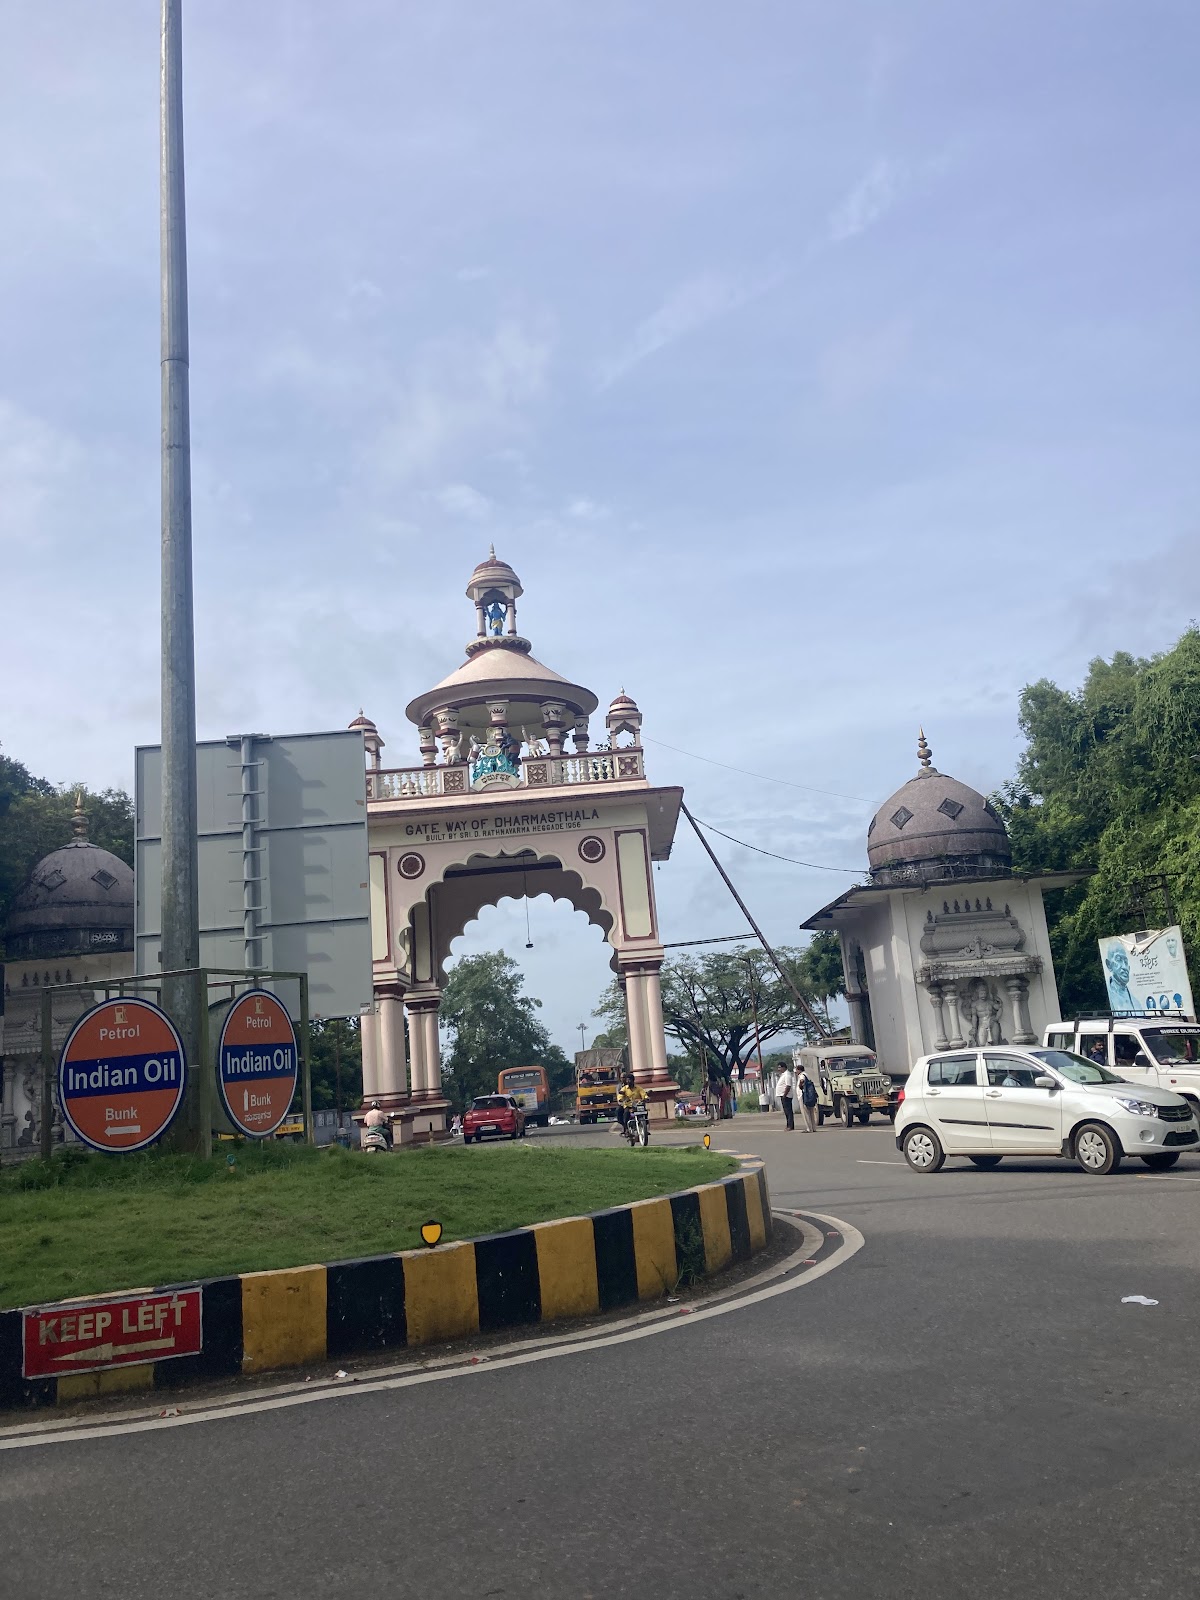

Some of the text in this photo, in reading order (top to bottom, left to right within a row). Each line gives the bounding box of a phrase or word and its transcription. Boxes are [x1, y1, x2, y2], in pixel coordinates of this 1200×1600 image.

[405, 808, 600, 836] GATE WAY OF DHARMASTHALA
[425, 833, 446, 842] BUILT
[448, 832, 457, 840] BY
[532, 822, 564, 832] HEGGADE
[246, 1016, 272, 1029] Petrol
[99, 1025, 140, 1041] Petrol
[226, 1049, 292, 1075] Indian Oil
[68, 1057, 176, 1091] Indian Oil
[250, 1094, 272, 1108] Bunk
[105, 1106, 138, 1122] Bunk
[39, 1301, 187, 1345] KEEP LEFT
